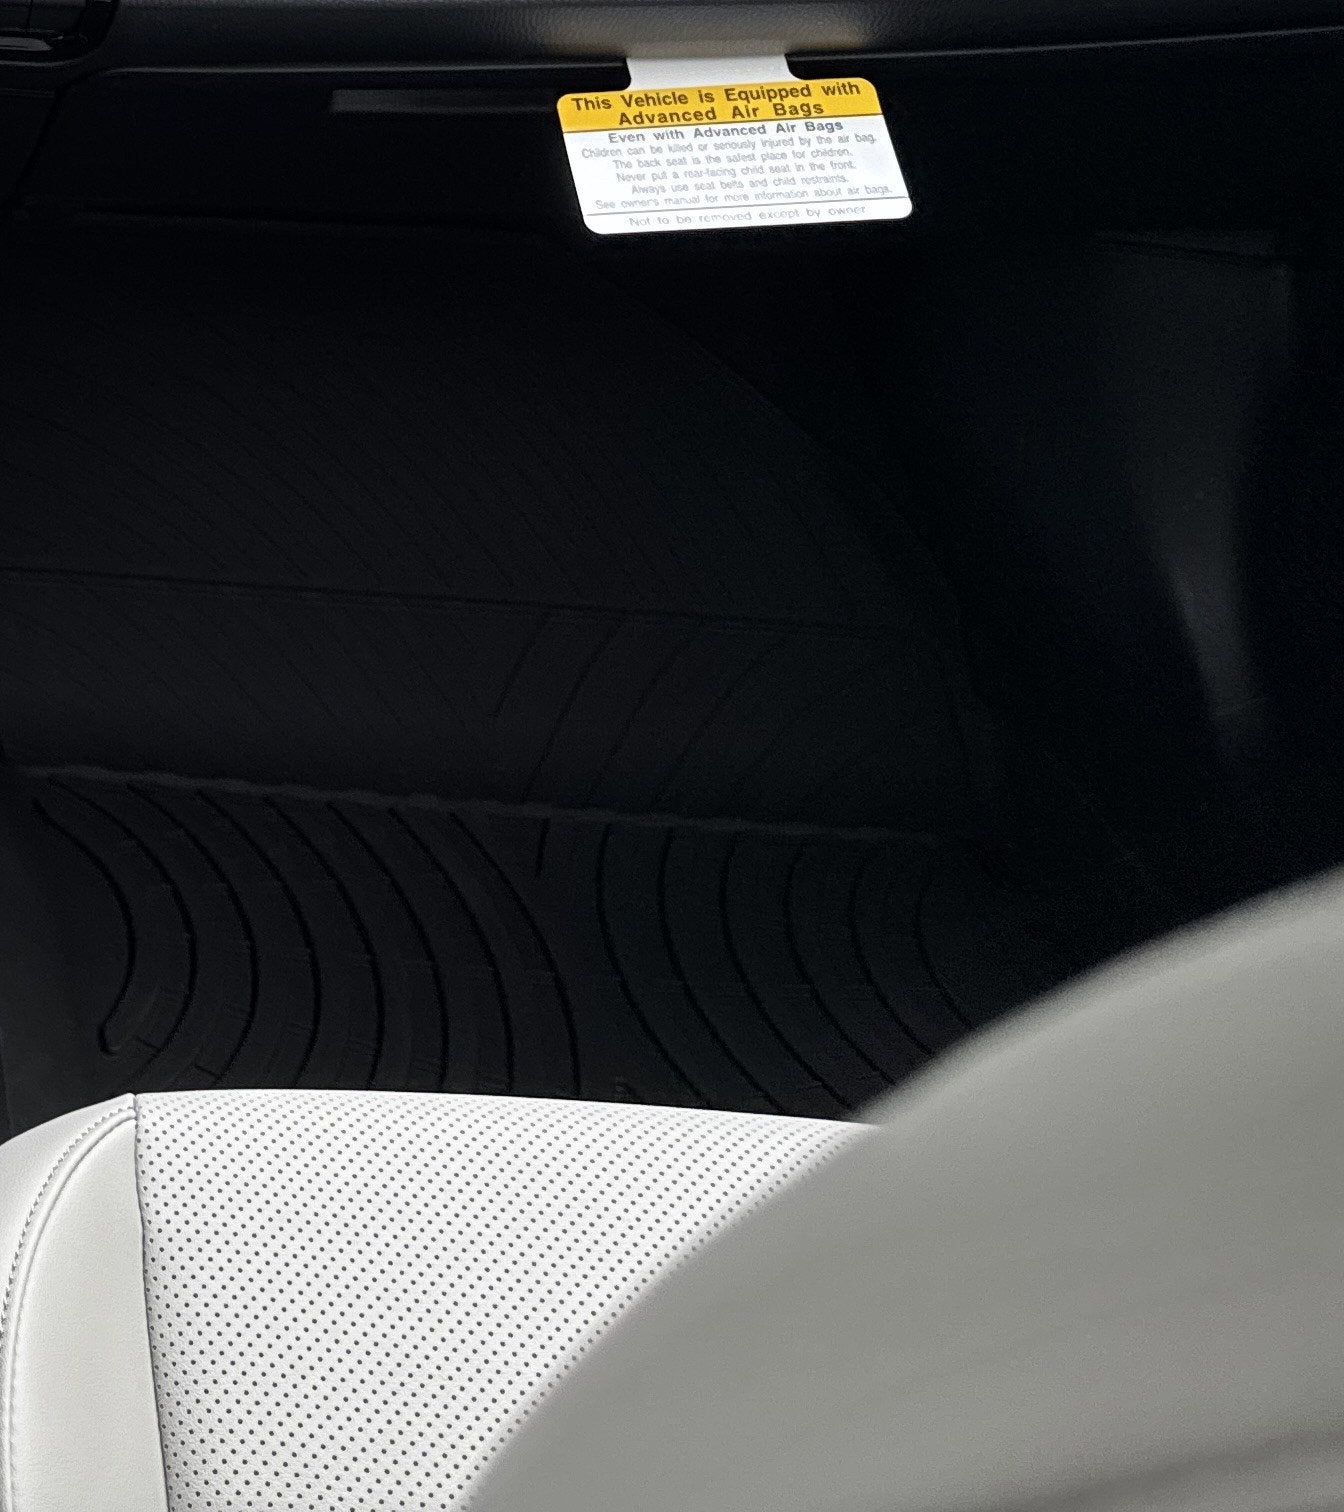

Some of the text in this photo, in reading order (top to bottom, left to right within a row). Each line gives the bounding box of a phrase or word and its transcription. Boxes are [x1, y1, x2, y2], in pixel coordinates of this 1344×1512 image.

[571, 81, 861, 112] This Vehicle is Equipped with
[618, 102, 825, 126] Advanced Air Bags
[608, 120, 844, 145] Even with Advanced Air Bags
[581, 147, 623, 159] Children
[626, 147, 645, 156] can
[649, 144, 663, 154] be
[668, 143, 694, 153] killed
[697, 144, 708, 152] or
[713, 139, 756, 151] seriously
[761, 136, 795, 148] injured
[798, 136, 812, 147] by
[816, 135, 833, 144] the
[837, 134, 850, 143] air
[612, 160, 633, 170] The
[637, 157, 662, 168] back
[666, 156, 688, 167] seat
[692, 155, 701, 164] is
[705, 154, 722, 164] the
[726, 152, 756, 164] safest
[761, 152, 788, 164] place
[791, 149, 806, 160] for
[615, 172, 646, 183] Never
[651, 169, 667, 182] put
[672, 171, 680, 179] a
[684, 167, 737, 179] rear-facing
[740, 163, 768, 175] child
[769, 162, 790, 173] seat
[794, 161, 805, 172] in
[810, 161, 826, 171] the
[631, 183, 667, 195] Always
[671, 183, 689, 192] use
[694, 181, 715, 191] seat
[720, 178, 745, 189] belts
[749, 177, 768, 188] and
[772, 176, 796, 187] child
[628, 205, 866, 226] Not to be removed except by owner
